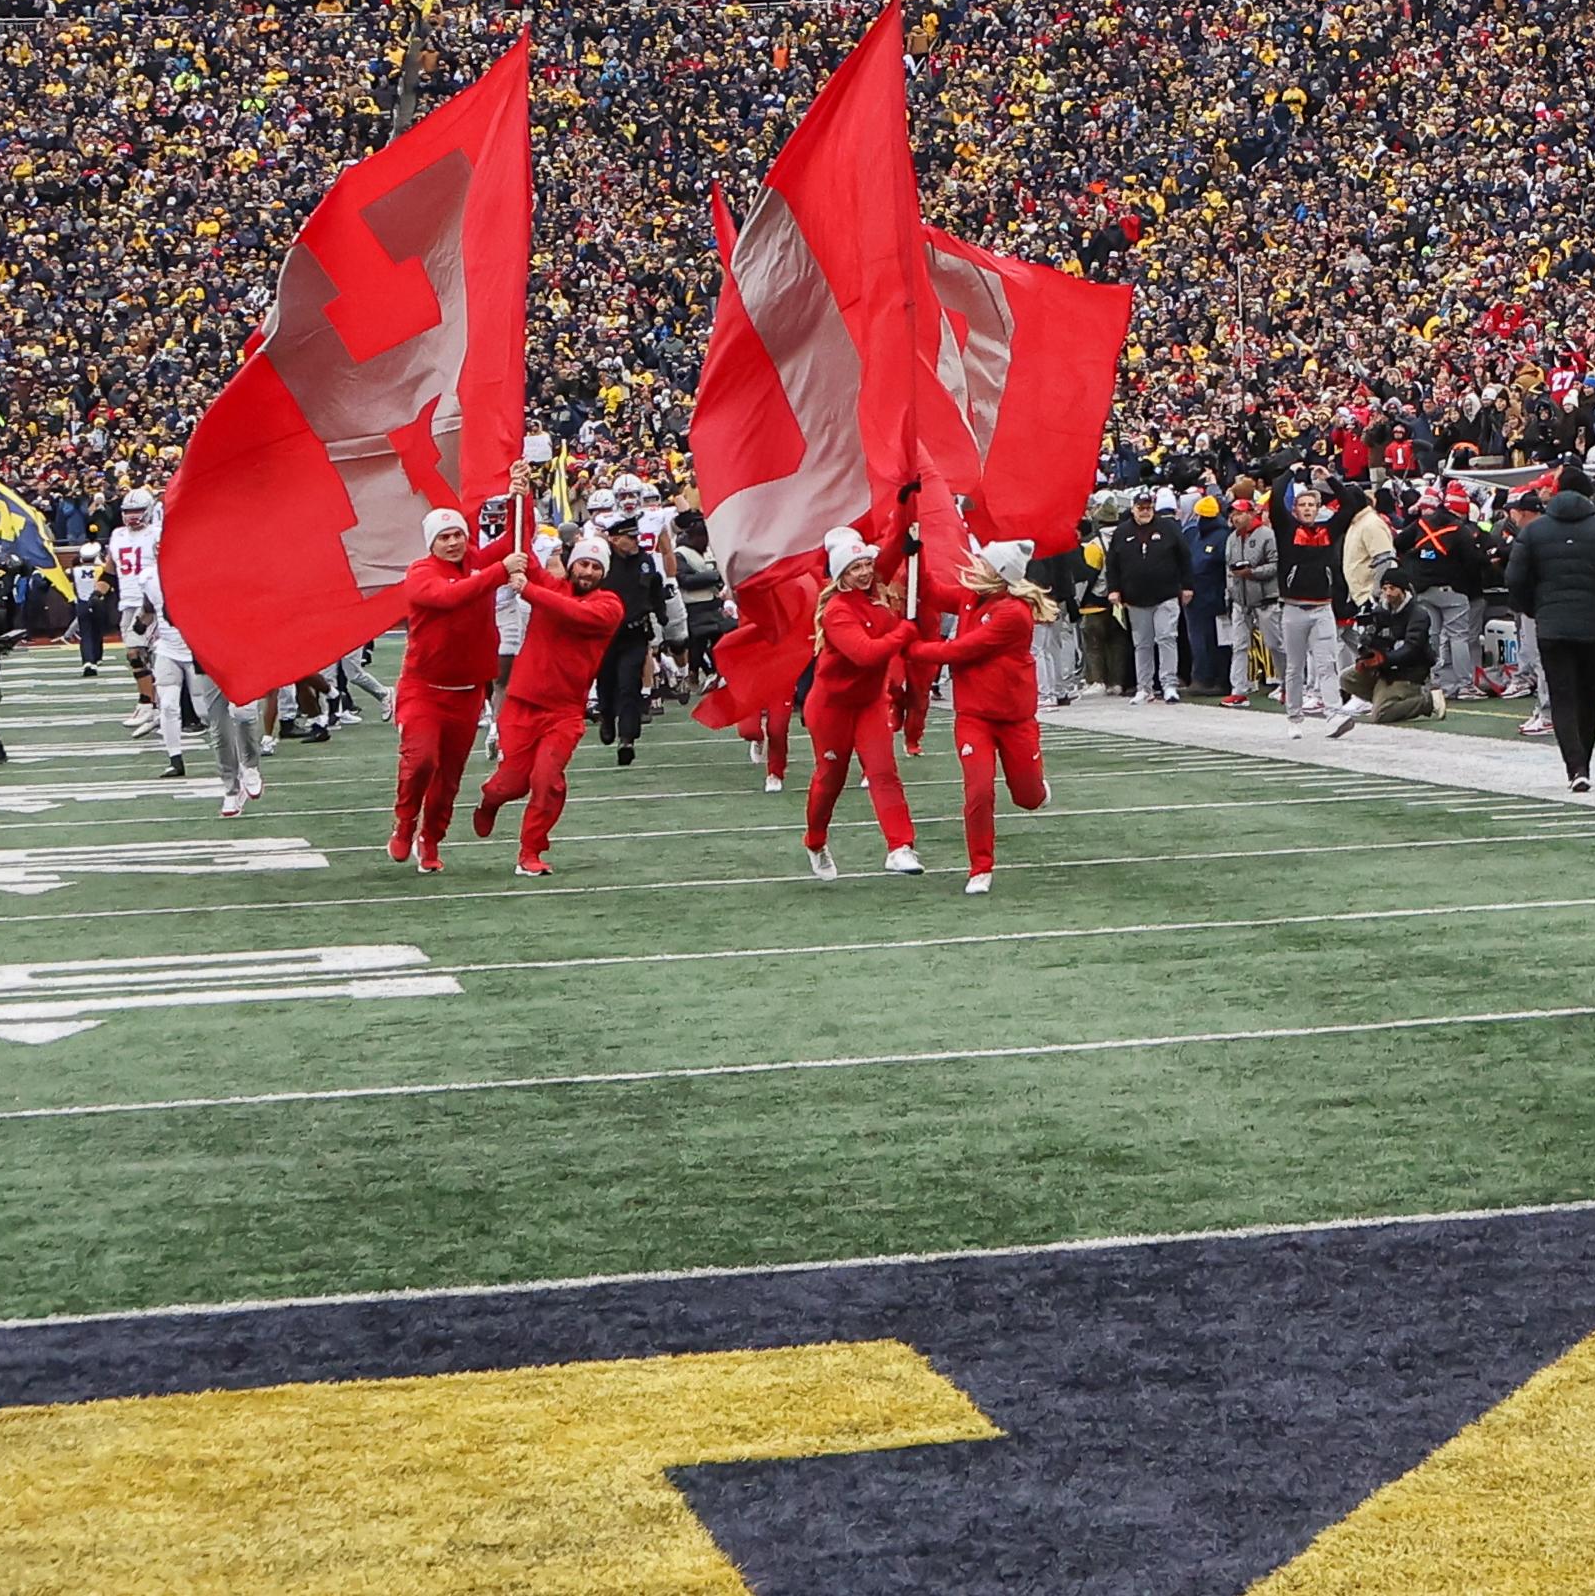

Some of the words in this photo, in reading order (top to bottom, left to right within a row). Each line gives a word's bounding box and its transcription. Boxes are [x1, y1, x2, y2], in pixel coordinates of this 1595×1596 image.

[1550, 371, 1575, 391] 27
[1396, 448, 1404, 464] 1
[118, 547, 142, 575] 51
